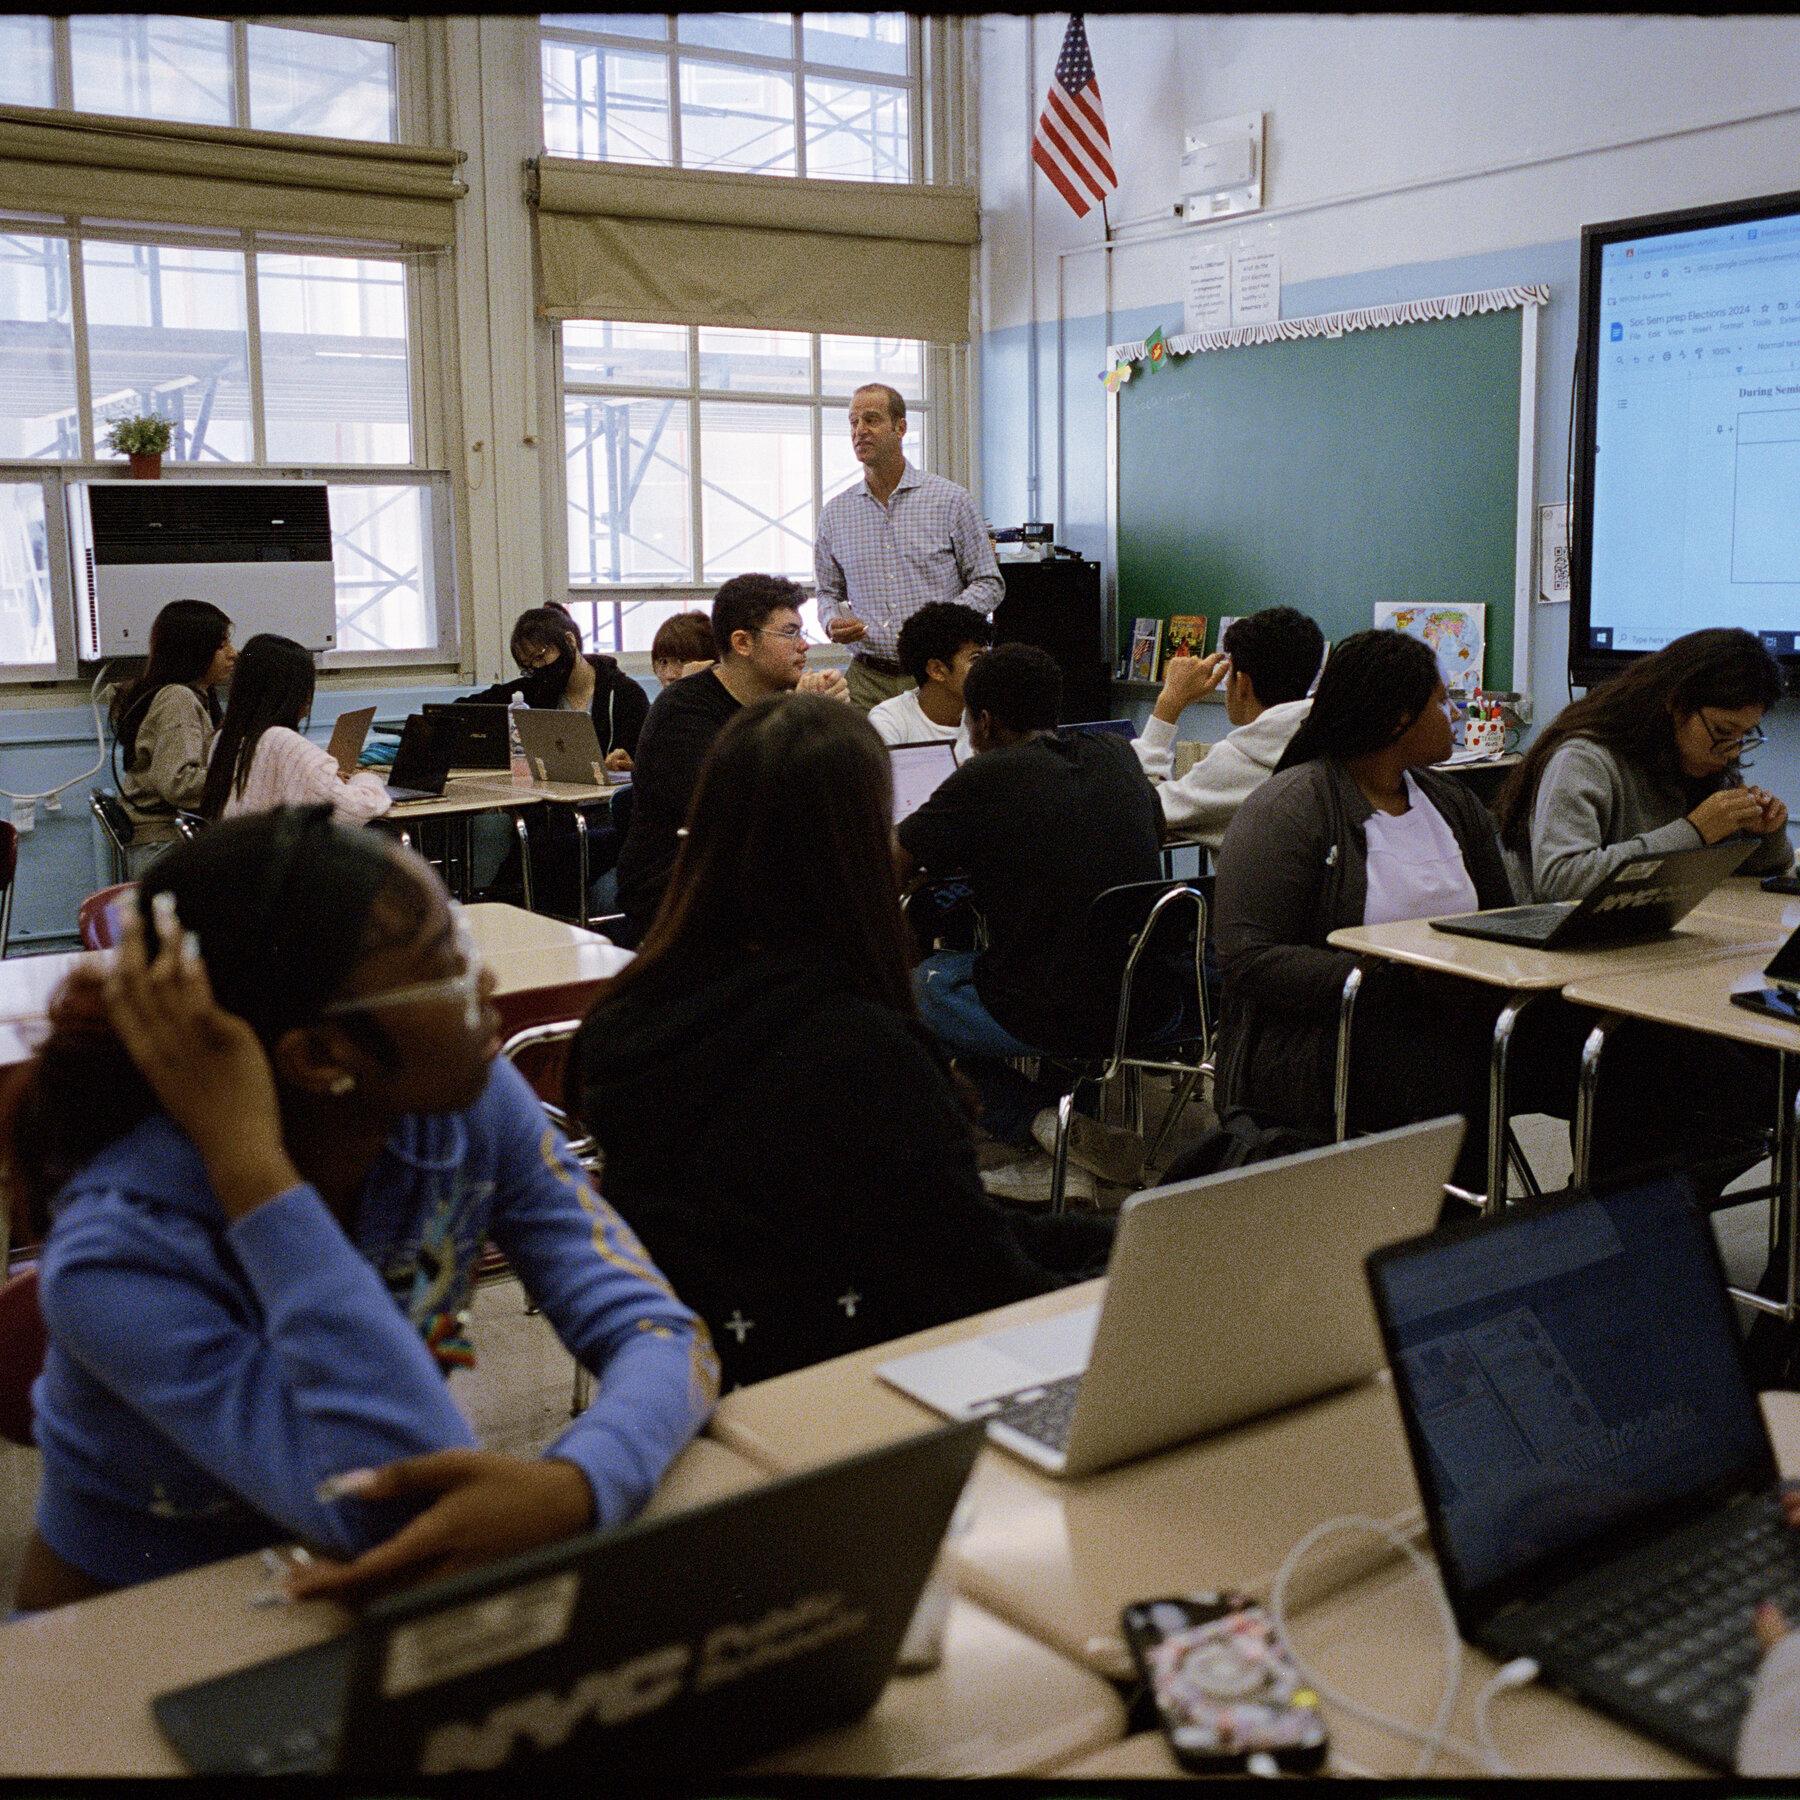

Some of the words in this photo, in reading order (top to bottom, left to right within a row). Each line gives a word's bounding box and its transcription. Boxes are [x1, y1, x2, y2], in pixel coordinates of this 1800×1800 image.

[1629, 317, 1645, 327] Soc
[1646, 315, 1665, 325] Sem
[1666, 313, 1687, 324] prep
[1688, 308, 1726, 321] Elections
[1728, 304, 1751, 316] 2024
[1738, 386, 1773, 399] During
